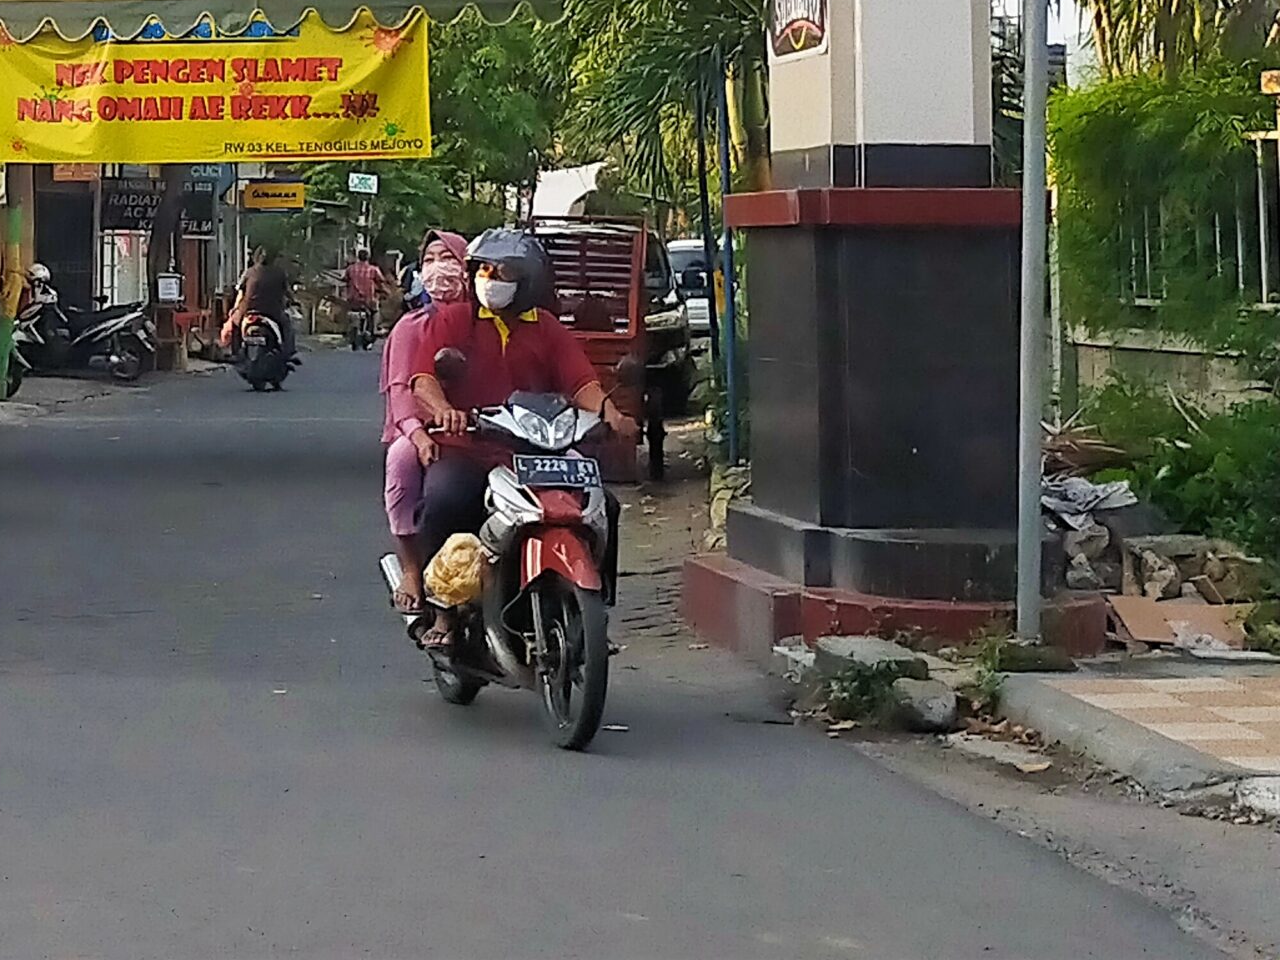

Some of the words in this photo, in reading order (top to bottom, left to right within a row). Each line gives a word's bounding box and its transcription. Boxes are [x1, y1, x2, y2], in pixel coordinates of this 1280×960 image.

[55, 60, 109, 87] NEK
[113, 59, 224, 83] PENGEN
[231, 57, 342, 82] SLAMET
[17, 96, 92, 122] NANG
[189, 95, 224, 120] AE
[224, 142, 245, 154] RW
[247, 142, 262, 153] 03
[298, 140, 368, 152] TENGGILIS
[370, 139, 423, 151] MEJOYO
[190, 165, 222, 178] CUCI
[109, 194, 162, 207] RADIAT
[181, 220, 212, 232] FILM
